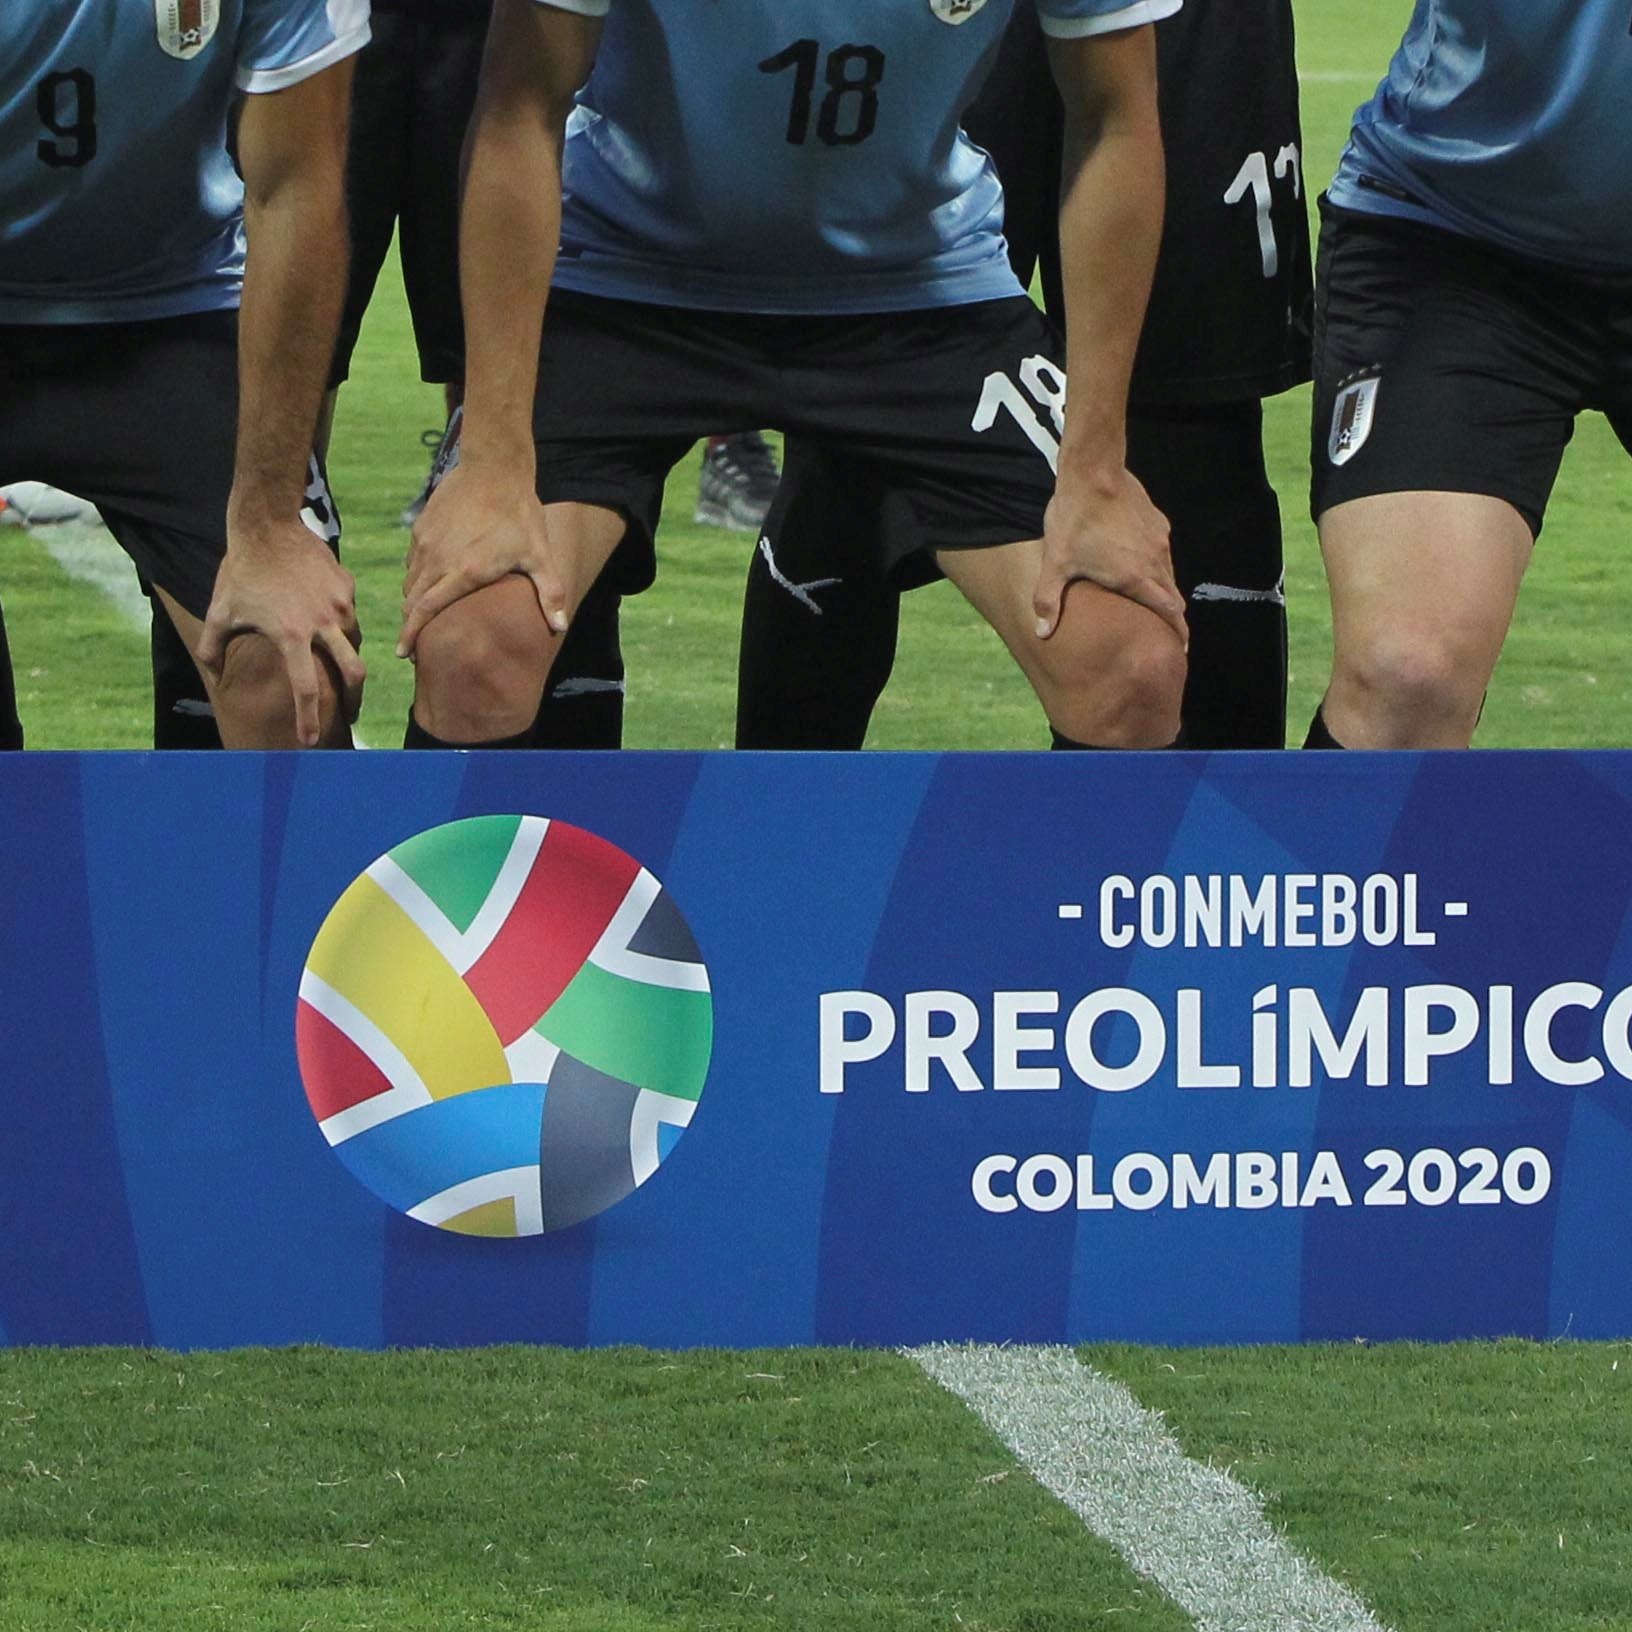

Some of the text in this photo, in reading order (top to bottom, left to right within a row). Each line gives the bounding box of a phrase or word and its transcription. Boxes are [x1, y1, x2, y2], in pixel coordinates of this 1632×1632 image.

[36, 68, 97, 167] 9
[758, 38, 885, 147] 18
[971, 1147, 1551, 1213] COLOMBIA 2020
